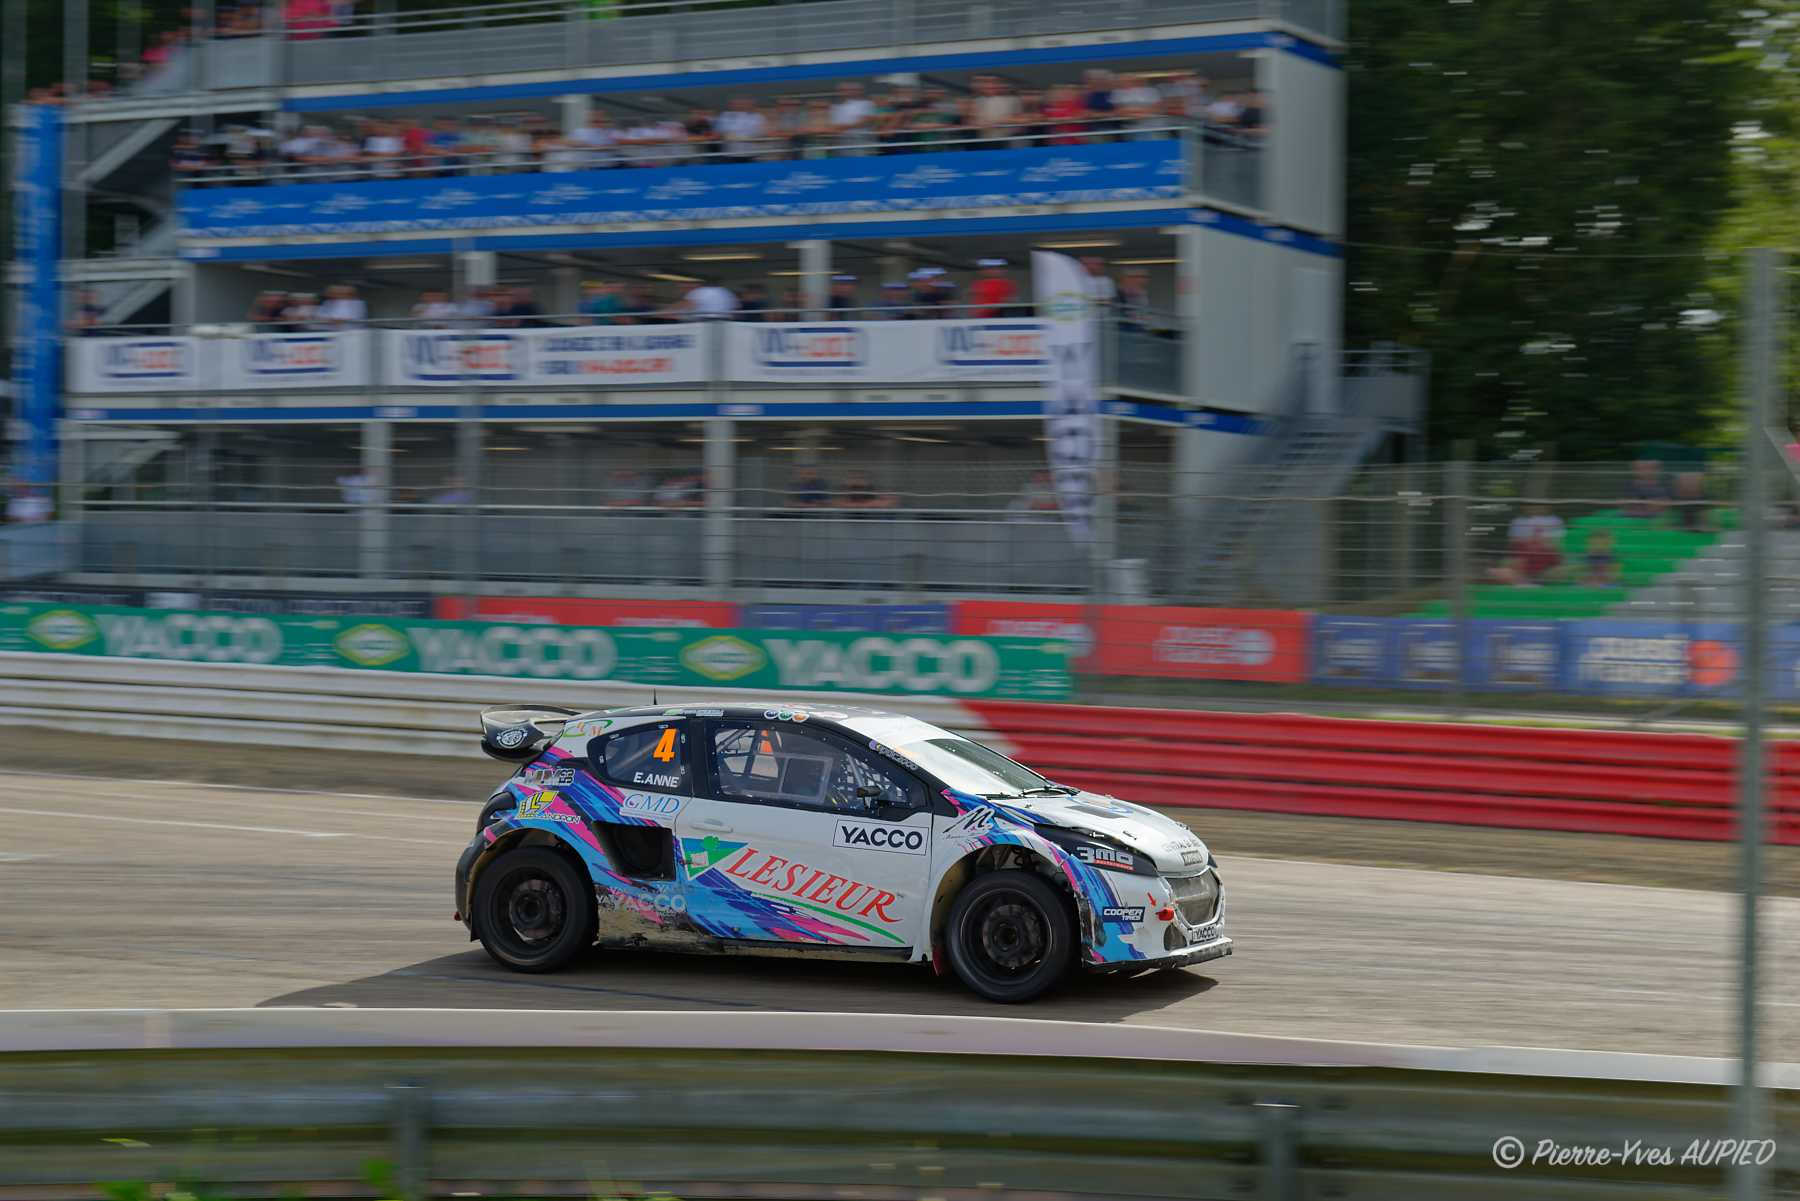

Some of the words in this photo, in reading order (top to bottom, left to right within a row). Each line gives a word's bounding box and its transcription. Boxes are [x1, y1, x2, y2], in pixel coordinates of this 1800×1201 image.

[97, 613, 283, 663] YACCO
[406, 626, 618, 678] YACCO
[762, 637, 997, 692] YACCO
[652, 728, 677, 763] 4
[633, 771, 680, 788] E.ANNE
[624, 793, 680, 814] GMD
[841, 825, 923, 850] YACCO
[726, 847, 904, 923] LESIEUR
[1103, 908, 1143, 916] COOPER
